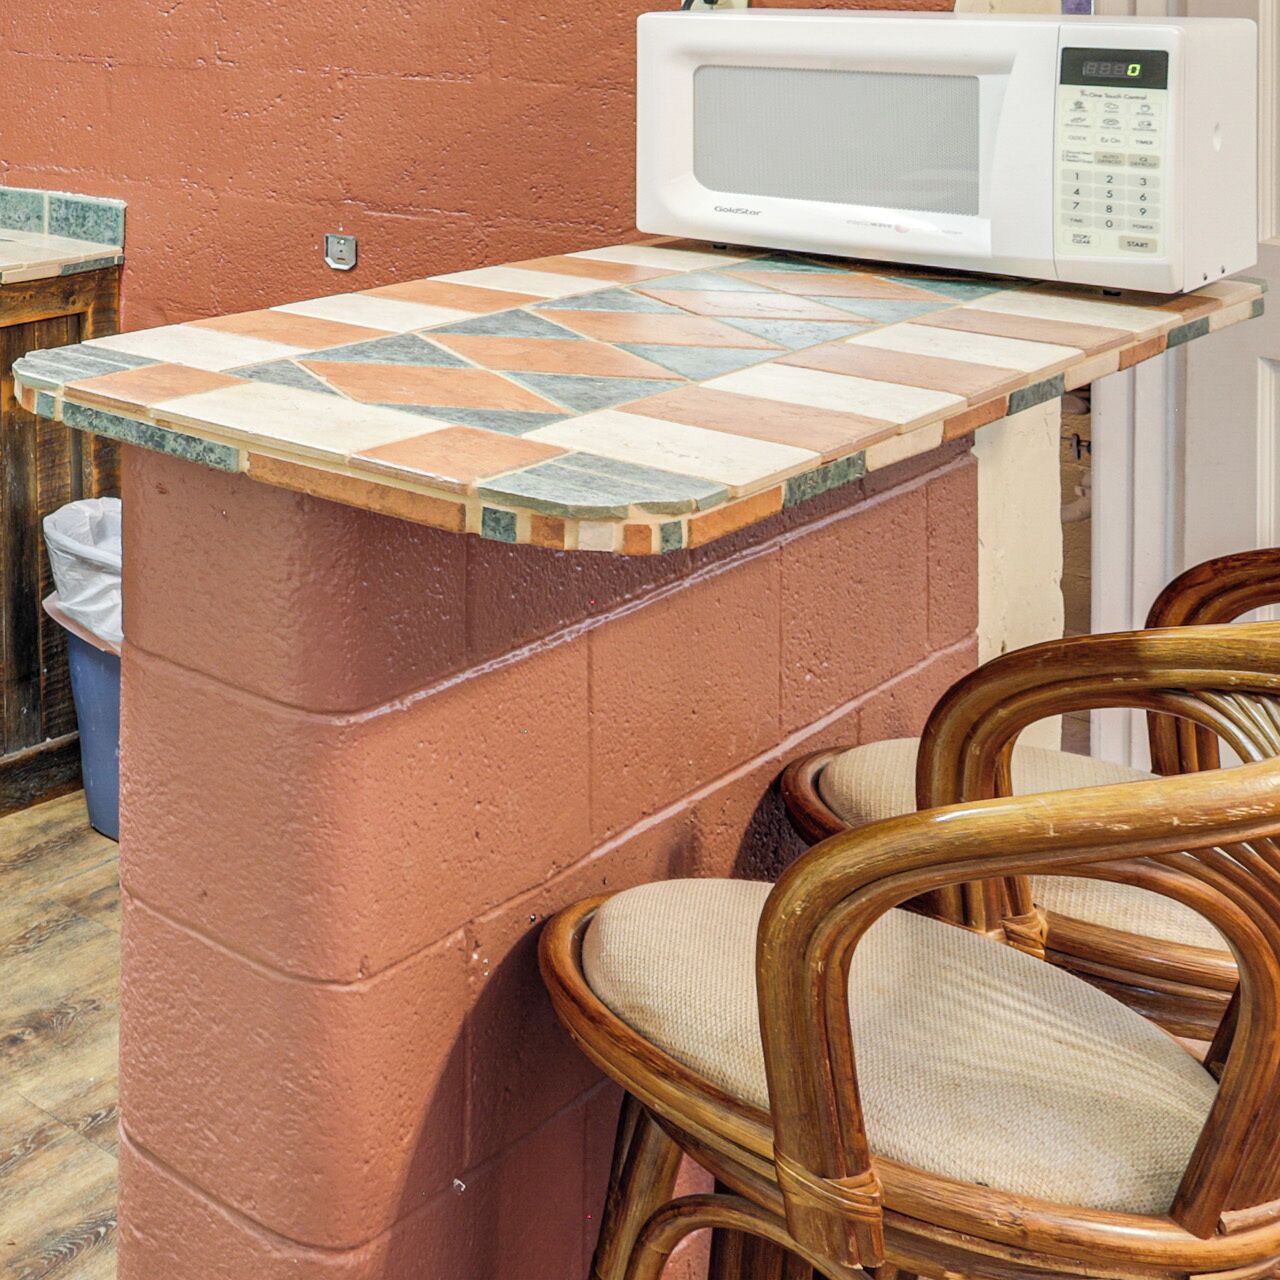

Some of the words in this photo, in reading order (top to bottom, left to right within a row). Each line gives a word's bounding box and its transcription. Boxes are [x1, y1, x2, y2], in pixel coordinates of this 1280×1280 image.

[1127, 64, 1141, 77] 0
[1106, 175, 1113, 184] 2
[1139, 177, 1147, 186] 3
[1106, 190, 1113, 199] 5
[1139, 193, 1147, 202] 6
[714, 205, 763, 216] GoldStar
[1073, 202, 1080, 210] 7
[1106, 205, 1113, 213] 8
[1139, 207, 1147, 216] 9
[1105, 219, 1113, 228] 0
